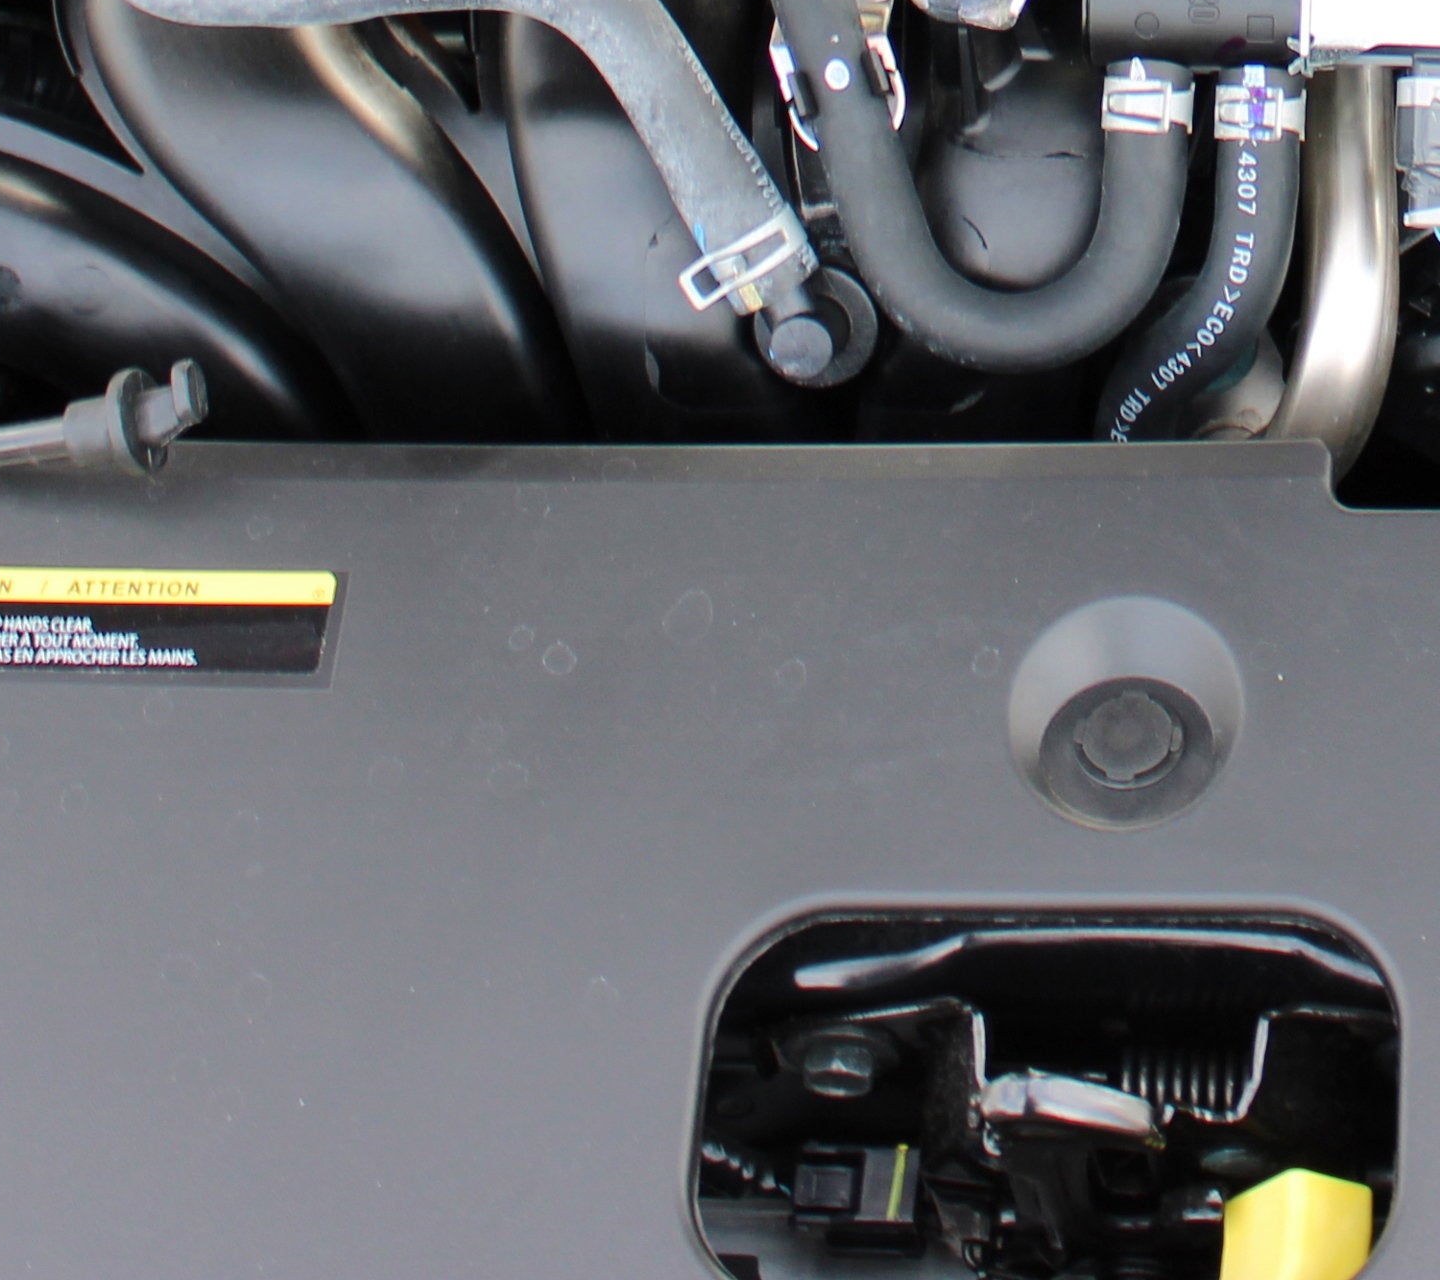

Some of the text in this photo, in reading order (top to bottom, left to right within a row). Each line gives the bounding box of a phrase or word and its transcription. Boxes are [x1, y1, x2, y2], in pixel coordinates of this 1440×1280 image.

[67, 580, 200, 597] ATTENTION
[3, 616, 49, 633] HANDS
[33, 632, 72, 649] TOUT
[12, 648, 35, 663] EN
[34, 648, 121, 665] APPROCHER
[120, 649, 147, 665] LES
